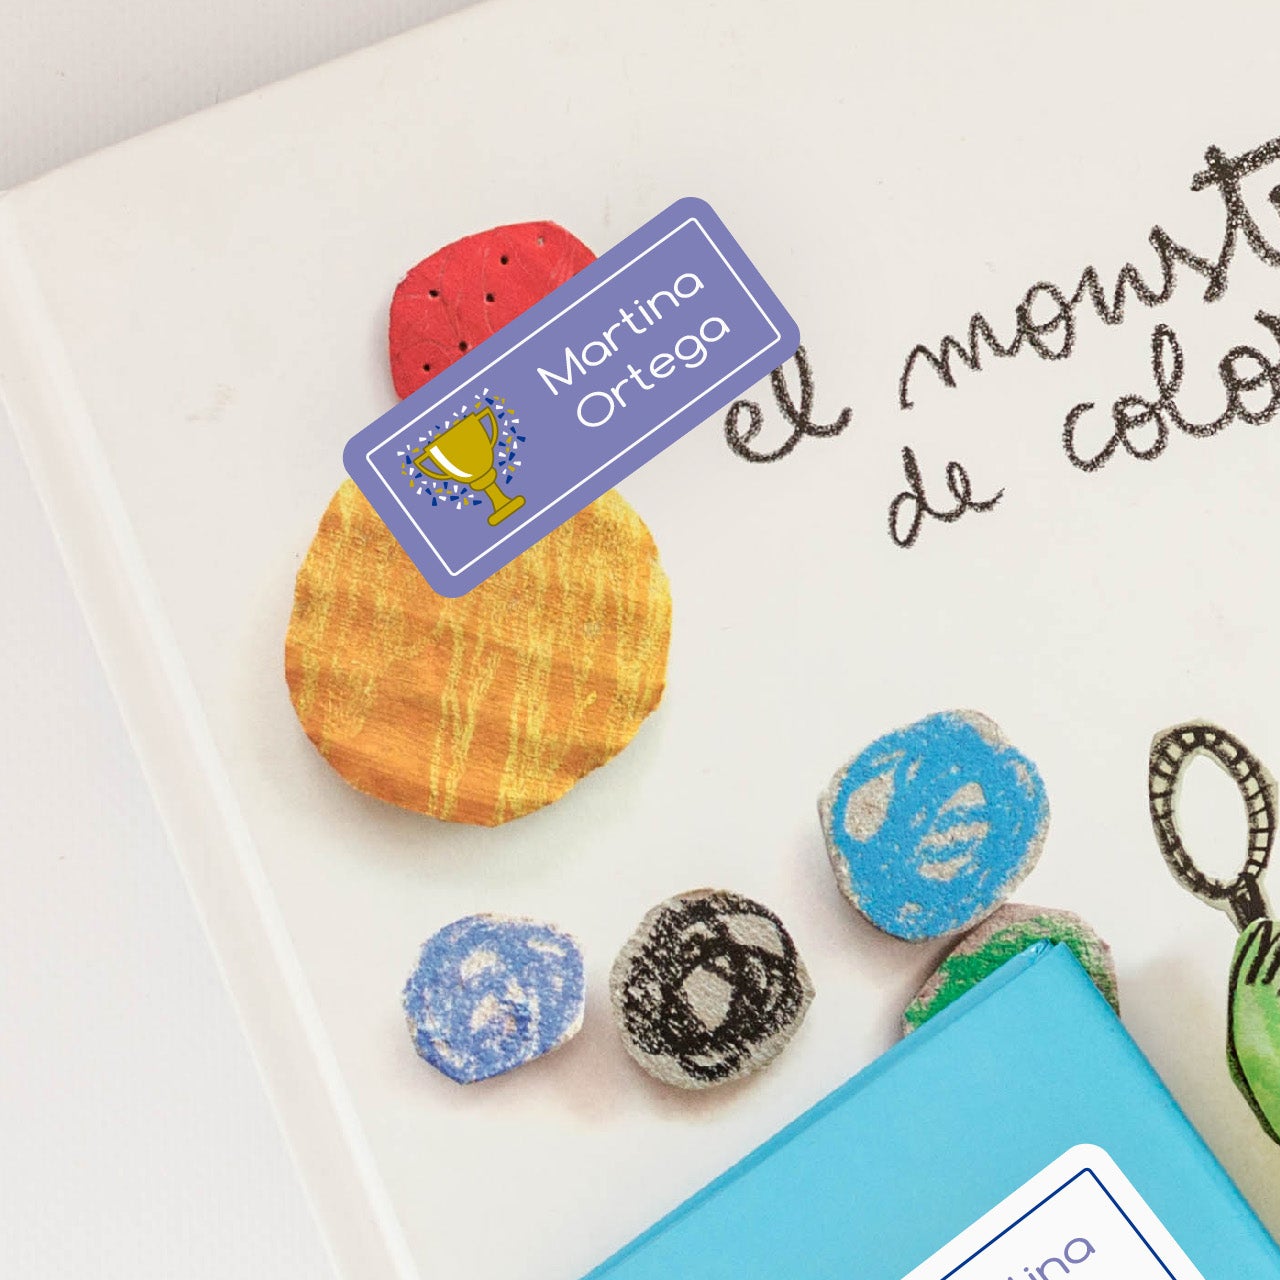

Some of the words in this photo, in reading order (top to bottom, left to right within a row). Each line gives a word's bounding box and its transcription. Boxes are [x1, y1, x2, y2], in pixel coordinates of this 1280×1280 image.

[537, 273, 704, 395] Martina
[577, 317, 730, 427] Ortega
[725, 346, 851, 463] el
[889, 447, 1002, 547] de
